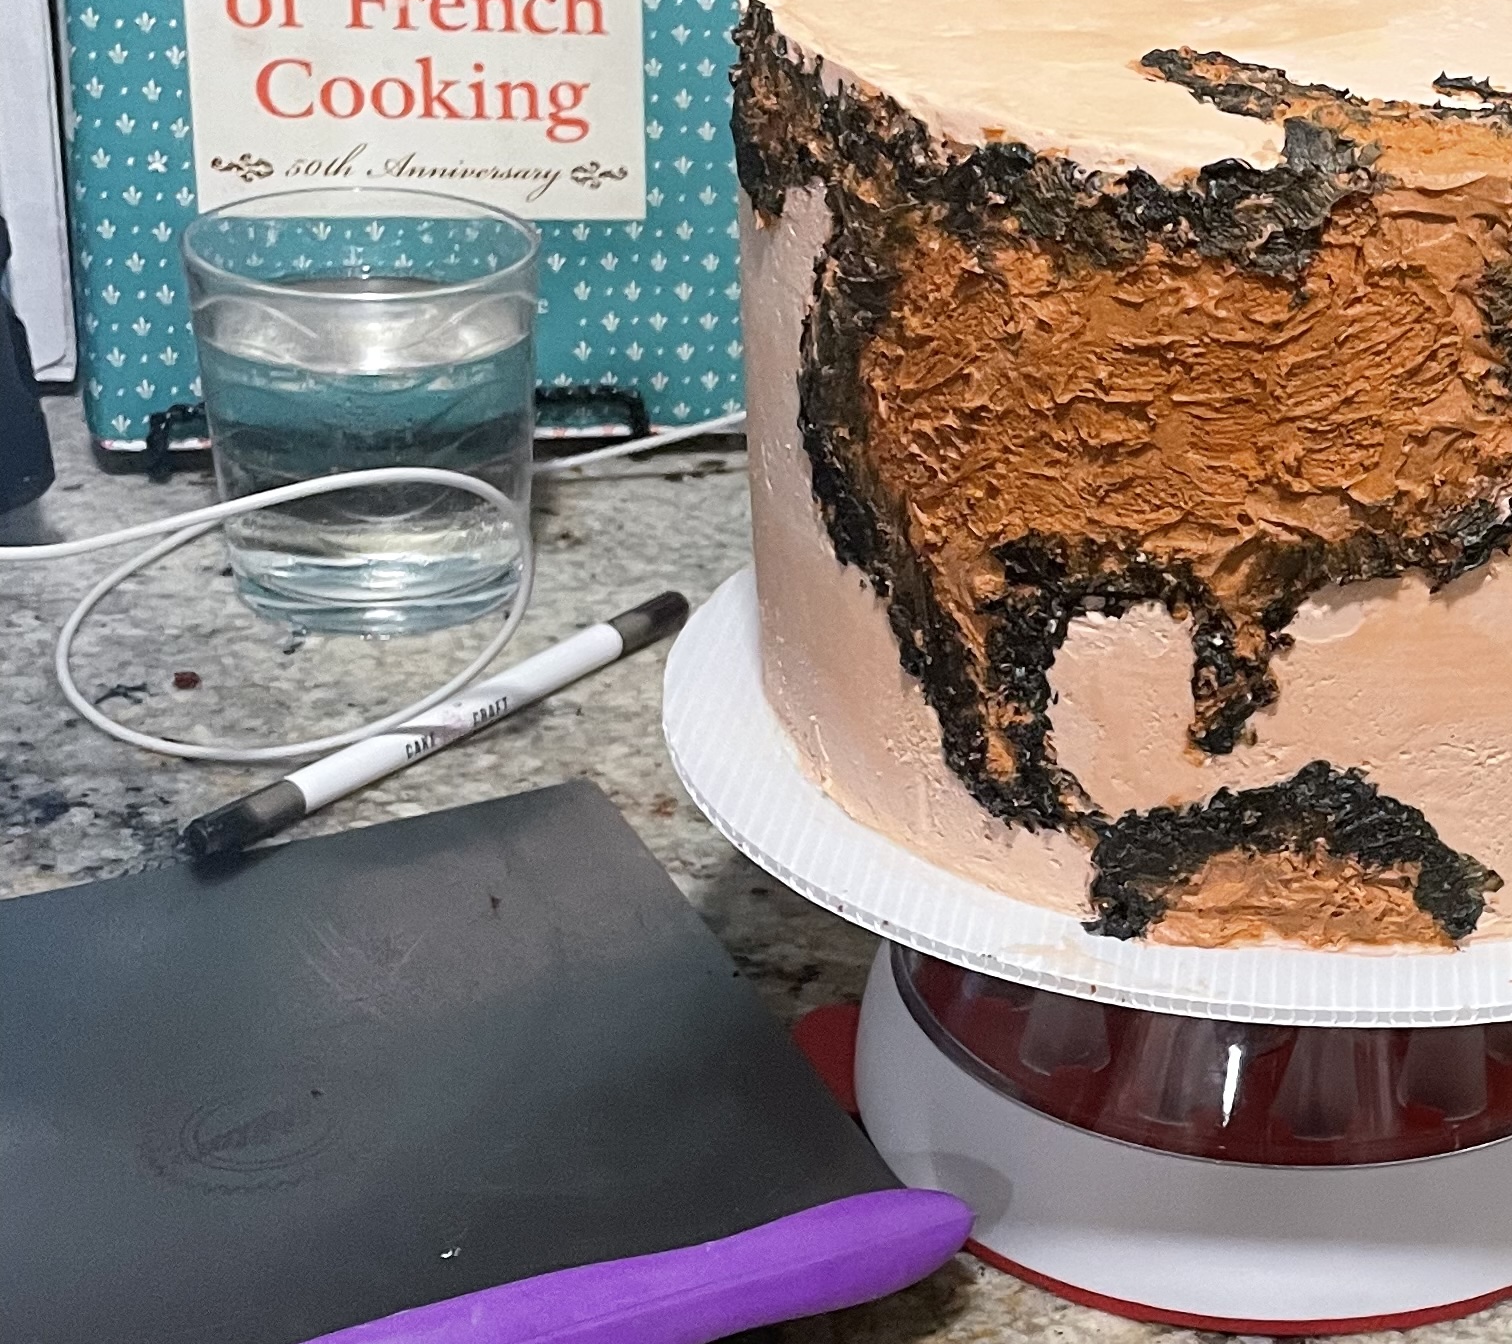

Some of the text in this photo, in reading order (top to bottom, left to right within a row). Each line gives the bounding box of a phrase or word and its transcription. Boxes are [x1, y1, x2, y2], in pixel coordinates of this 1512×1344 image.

[255, 57, 591, 143] Cooking
[284, 142, 562, 203] 50th Anniversary
